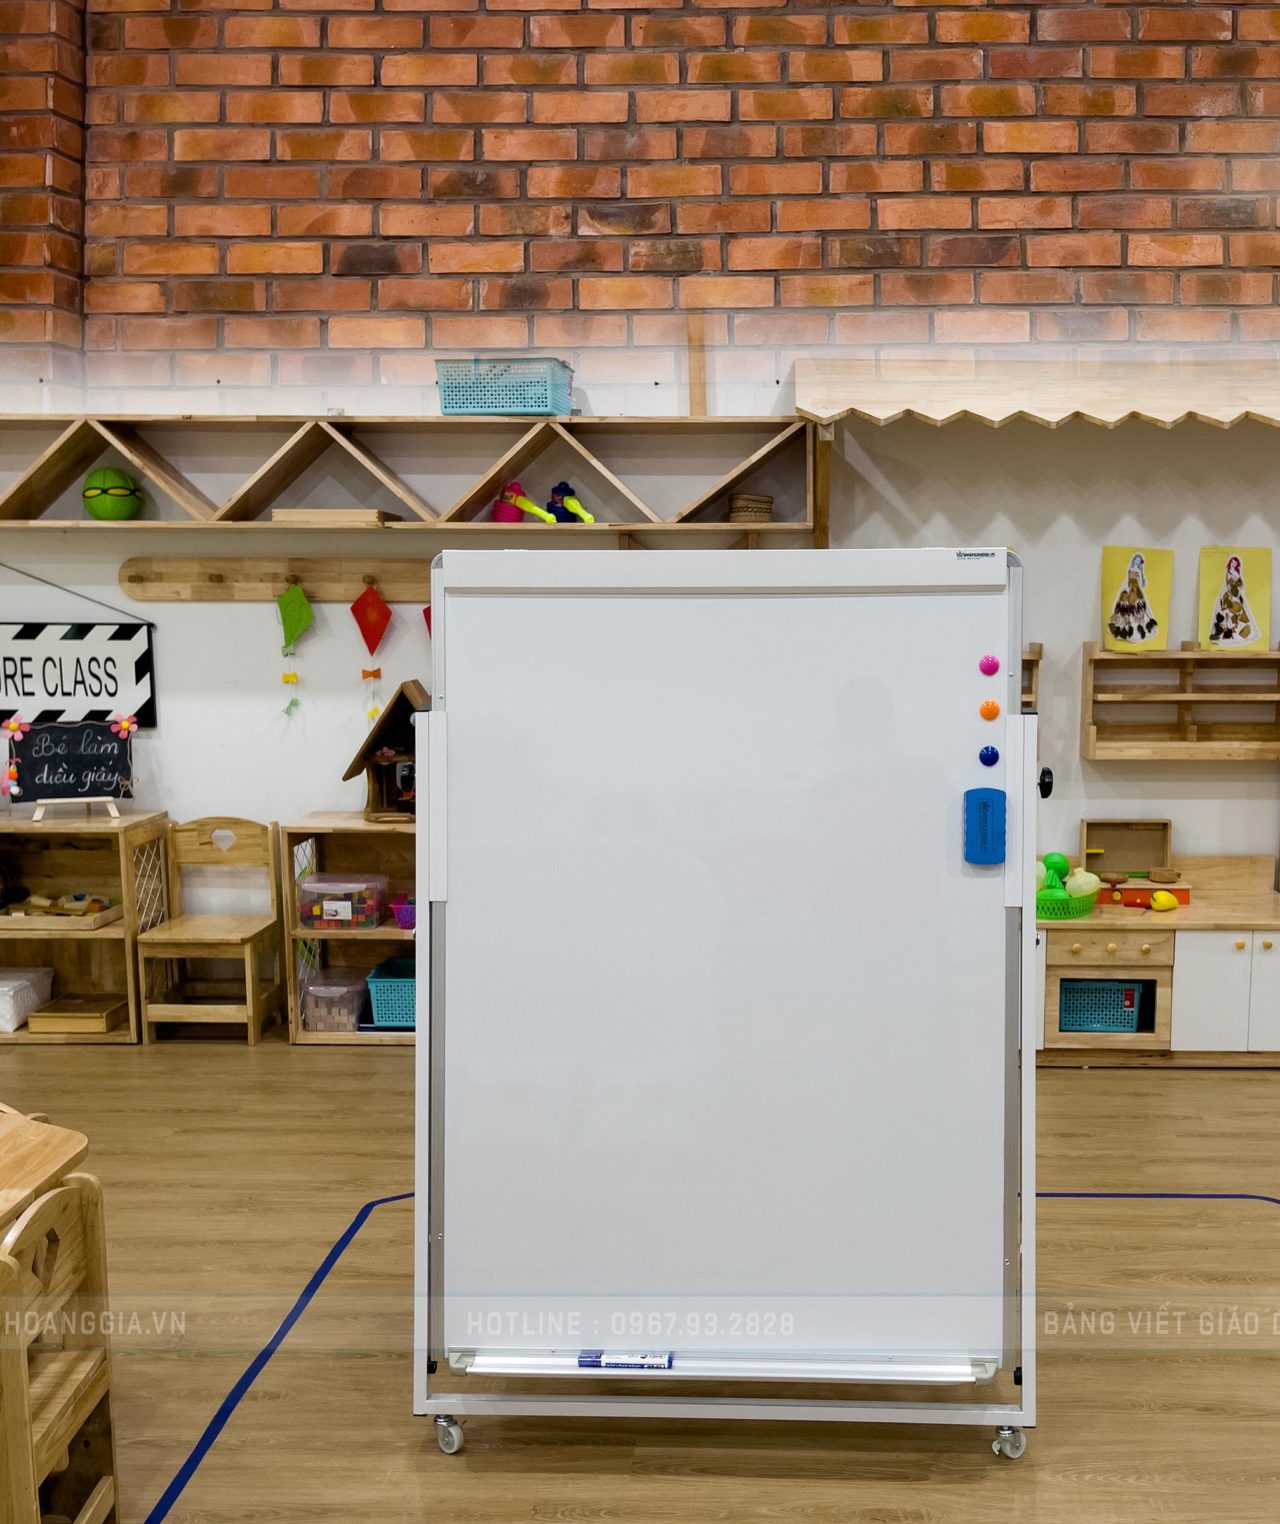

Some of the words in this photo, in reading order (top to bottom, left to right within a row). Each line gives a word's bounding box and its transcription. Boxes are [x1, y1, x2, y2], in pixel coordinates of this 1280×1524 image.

[0, 656, 35, 697] RE
[42, 656, 118, 697] CLASS
[32, 733, 68, 758] Bé
[79, 729, 119, 756] làm
